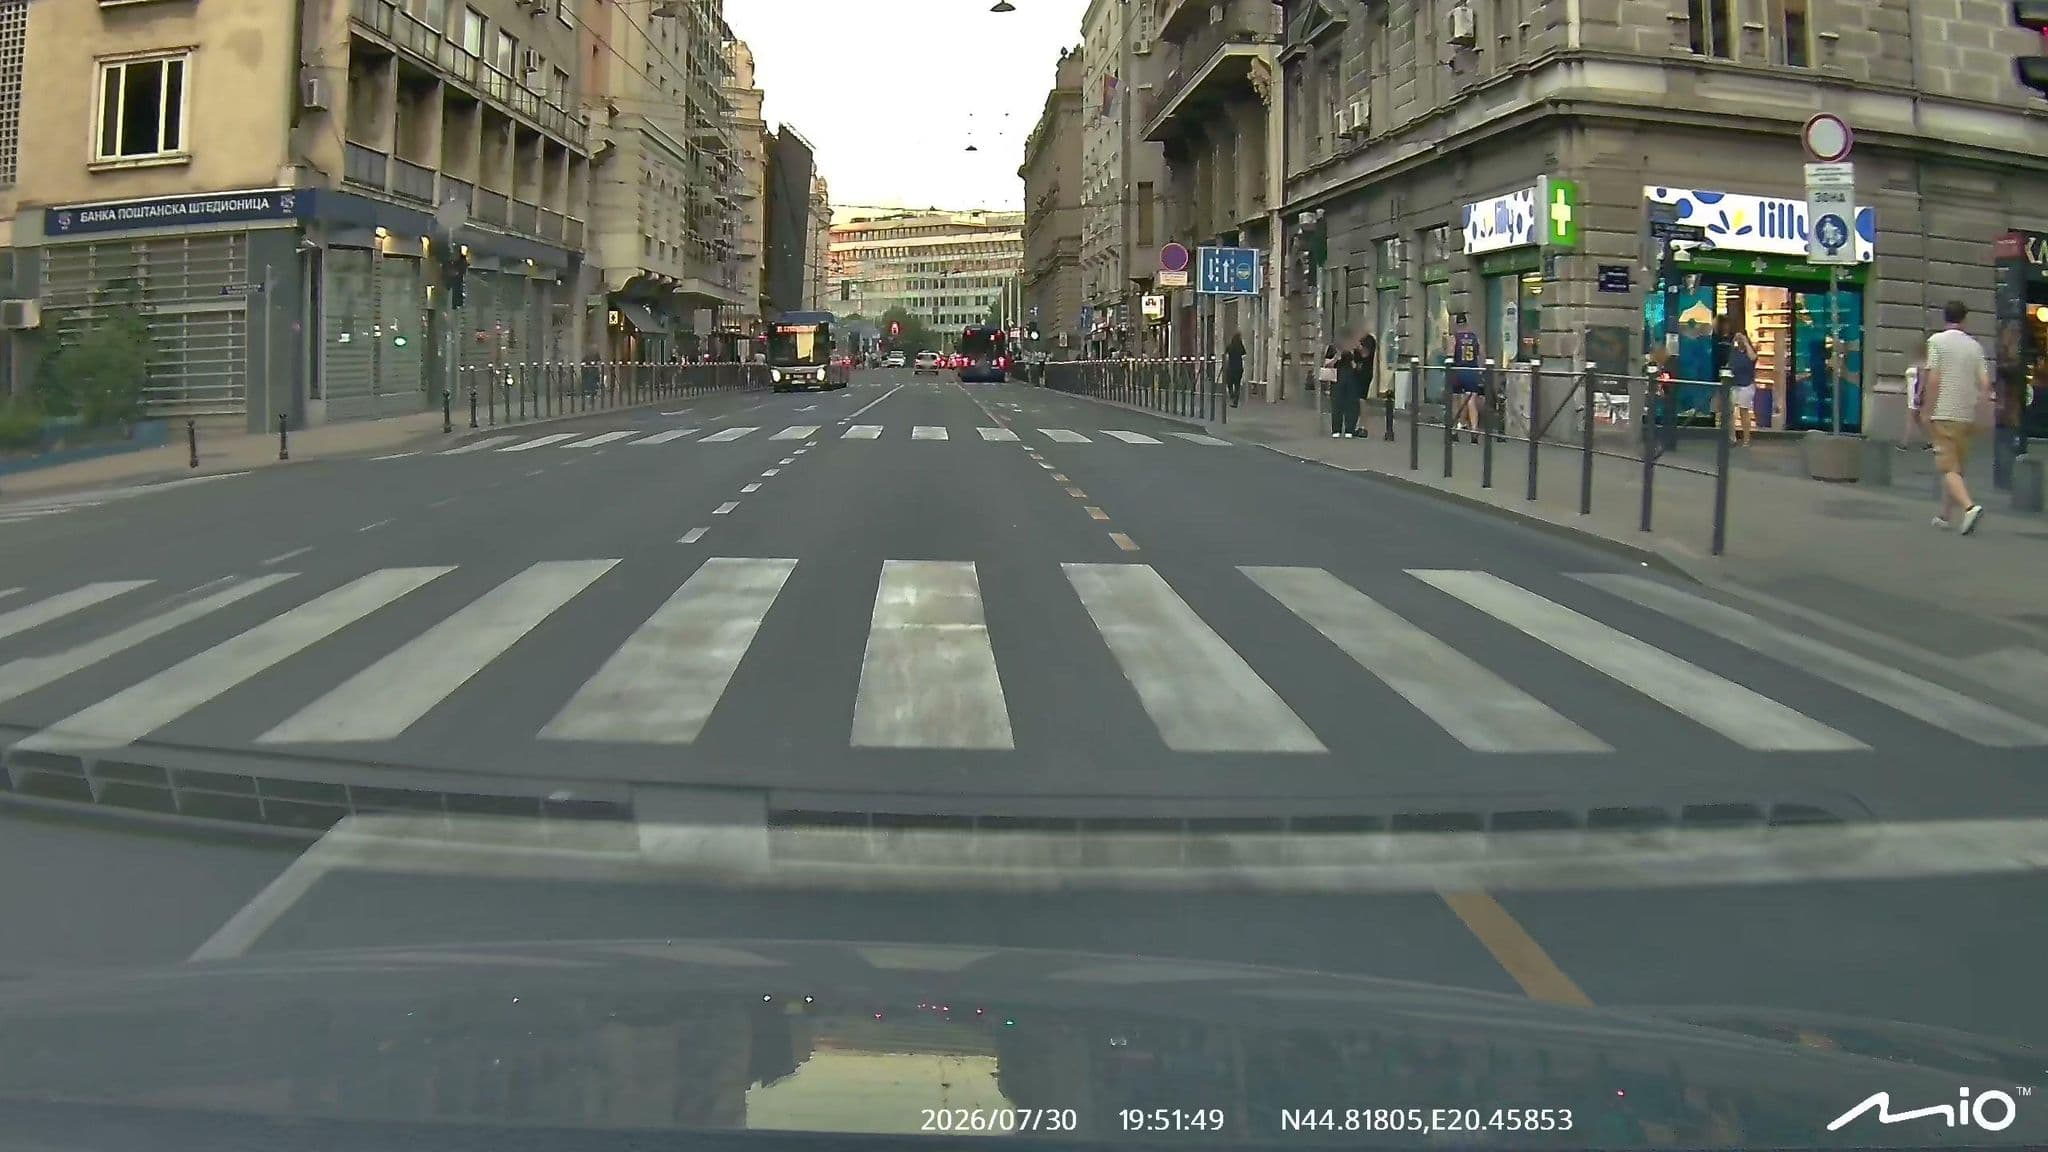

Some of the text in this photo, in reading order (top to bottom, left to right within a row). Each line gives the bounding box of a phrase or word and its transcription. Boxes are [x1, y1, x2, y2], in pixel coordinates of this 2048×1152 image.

[79, 197, 270, 223] БАНКА ПОШТАНСКА ШТЕДИОНИЦА
